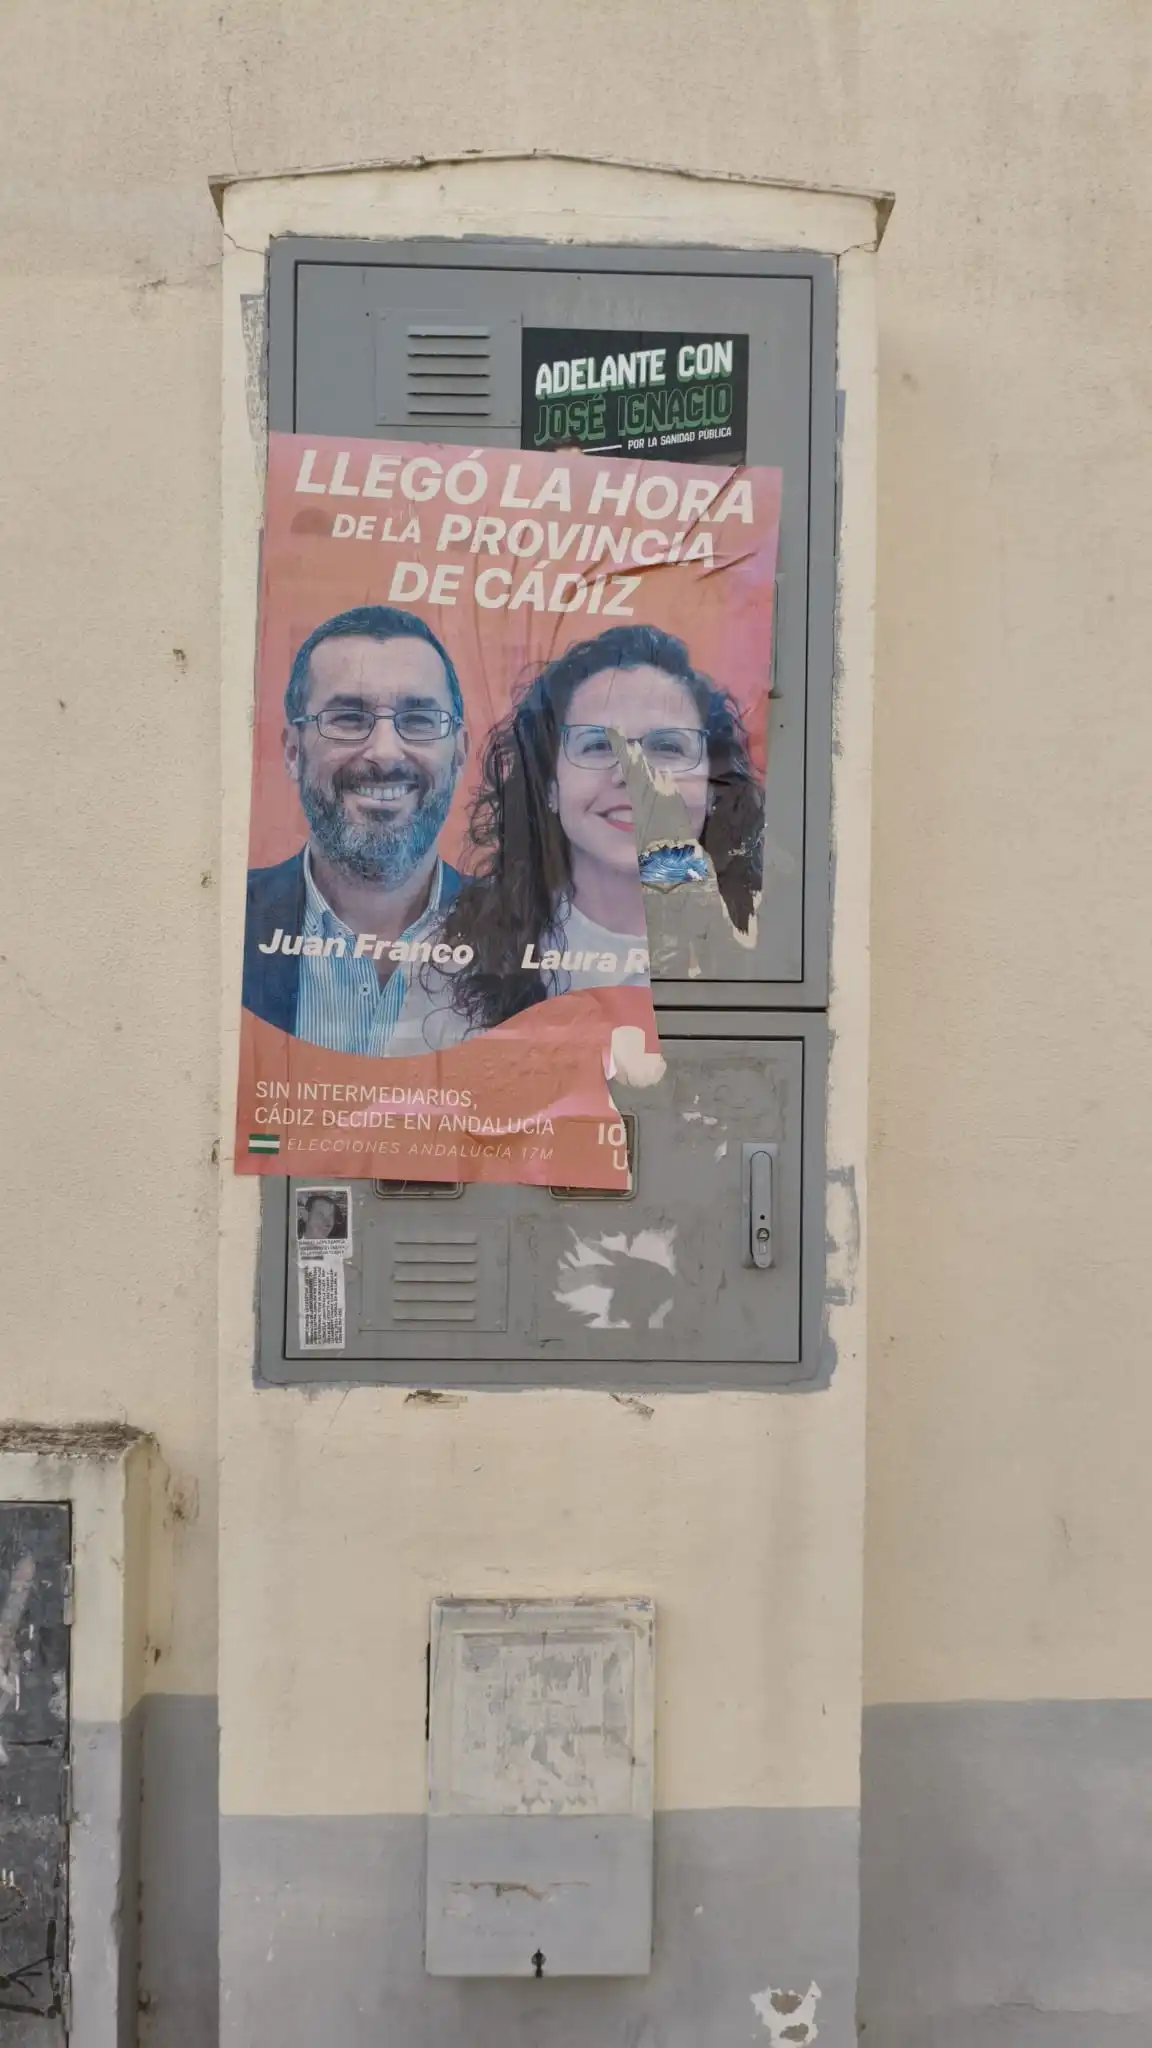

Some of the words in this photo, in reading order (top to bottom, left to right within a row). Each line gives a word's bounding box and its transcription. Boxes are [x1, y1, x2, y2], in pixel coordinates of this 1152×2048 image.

[535, 349, 666, 399] ADELANTE
[677, 340, 733, 382] CON
[534, 393, 606, 446] JOSÉ
[617, 383, 733, 436] IGNACIO
[628, 439, 645, 450] POR
[648, 438, 658, 447] LA
[660, 432, 695, 446] SANIDAD
[698, 427, 732, 441] PÚBLICA
[295, 449, 488, 505] LLEGÓ
[500, 463, 571, 512] LA
[587, 471, 754, 524] HORA
[332, 514, 376, 541] DE
[381, 517, 422, 544] LA
[436, 514, 716, 568] PROVINCIA
[388, 562, 465, 605] DE
[473, 557, 642, 617] CÁDIZ
[258, 929, 346, 959] Juan
[352, 933, 474, 965] Franco
[521, 944, 618, 972] Laura
[255, 1081, 290, 1099] SIN
[297, 1083, 478, 1110] INTERMEDIARIOS,
[255, 1102, 314, 1127] CÁDIZ
[322, 1110, 395, 1130] DECIDE
[404, 1114, 431, 1130] EN
[438, 1115, 555, 1136] ANDALUCÍA
[287, 1138, 400, 1155] ELECCIONES
[408, 1143, 512, 1159] ANDALUCÍA
[521, 1147, 554, 1161] 17M
